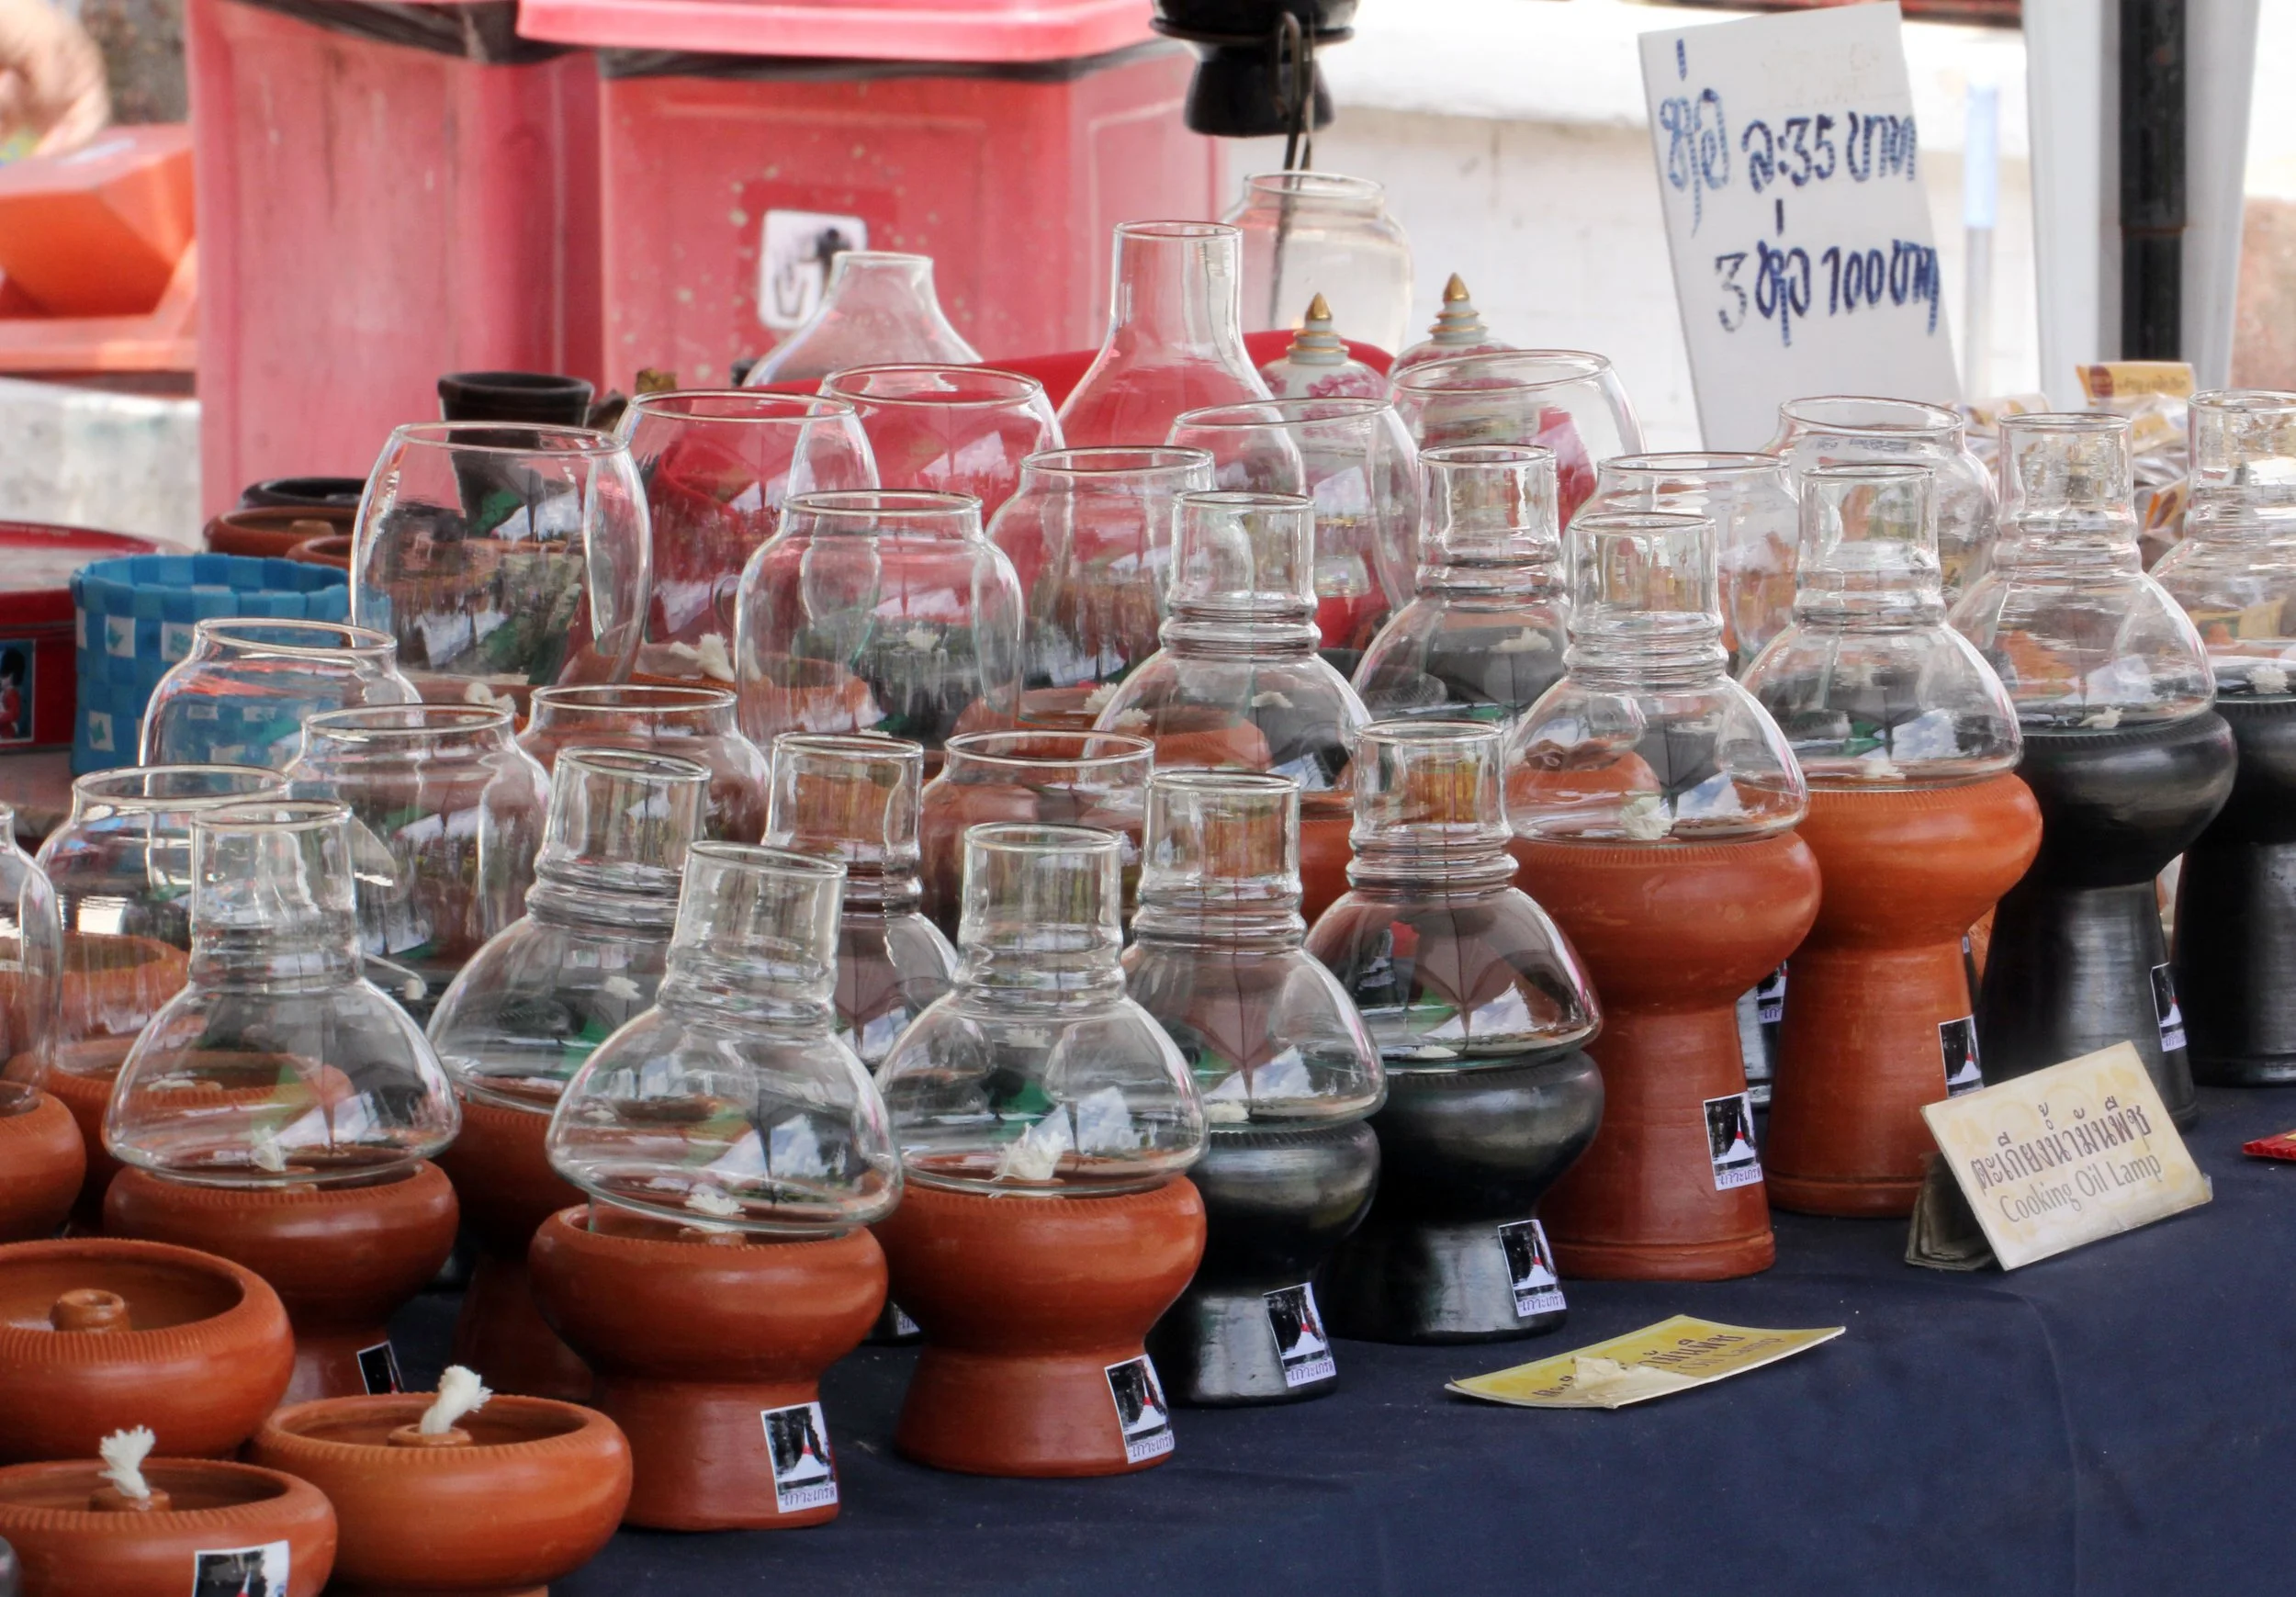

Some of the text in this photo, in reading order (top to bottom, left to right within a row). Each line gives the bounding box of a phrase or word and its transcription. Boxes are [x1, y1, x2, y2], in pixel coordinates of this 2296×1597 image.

[1999, 1154, 2162, 1222] Cooking Oil Lamp
